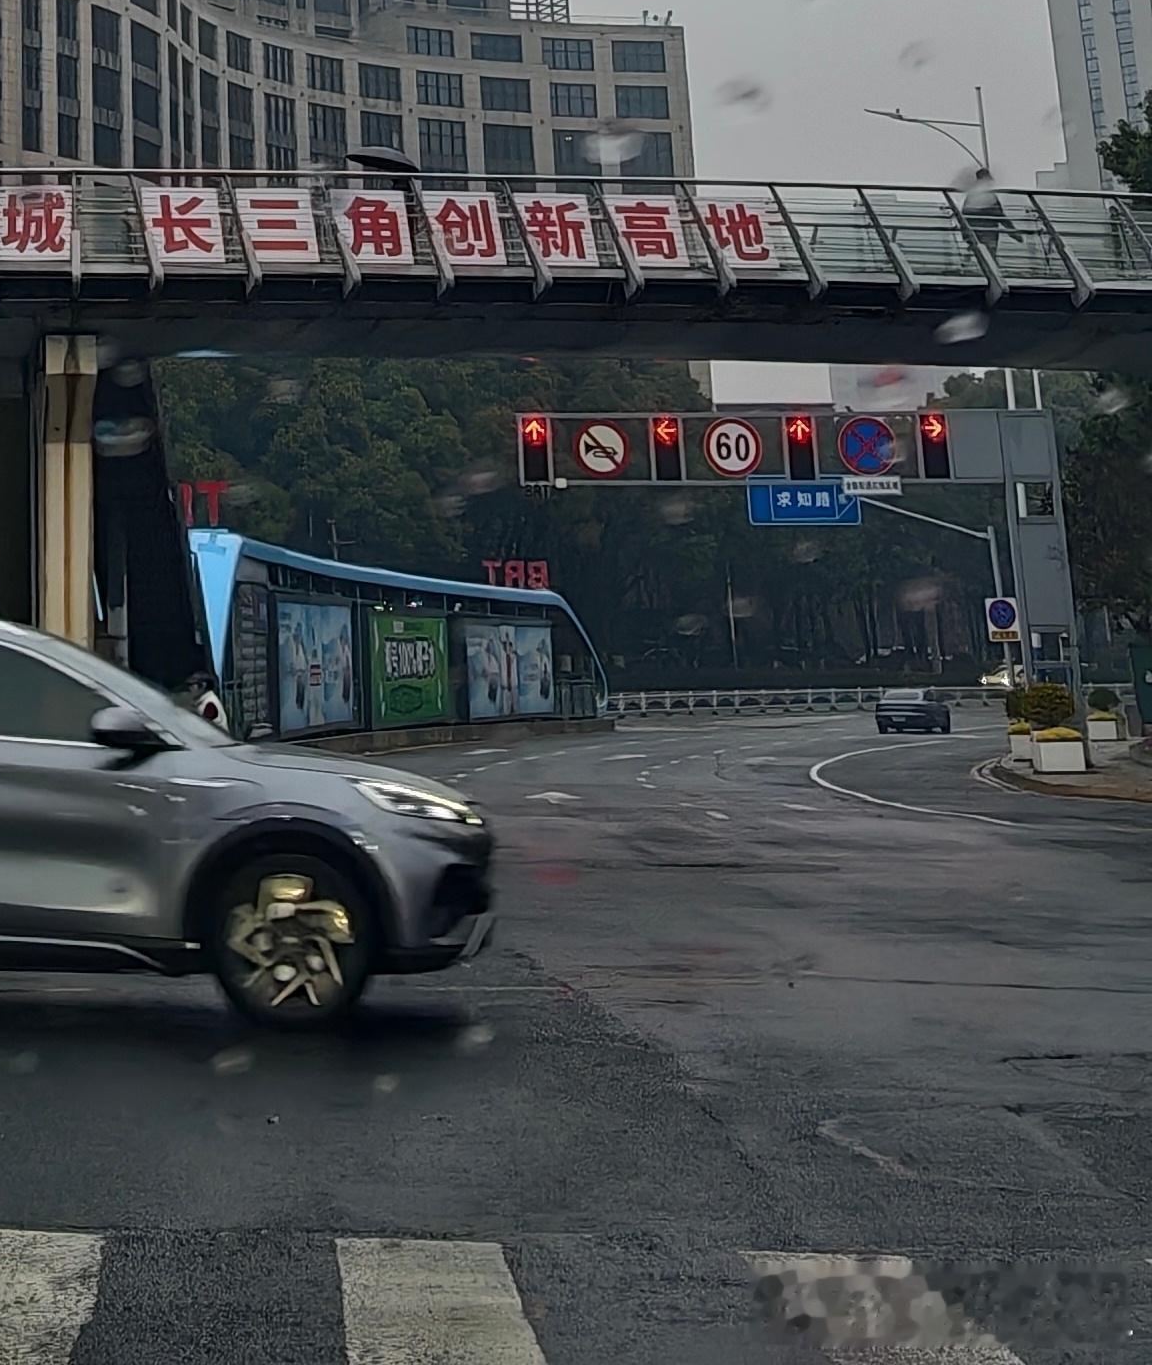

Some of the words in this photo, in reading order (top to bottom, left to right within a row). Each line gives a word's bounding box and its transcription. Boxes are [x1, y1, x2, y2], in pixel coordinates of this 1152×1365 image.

[151, 194, 770, 261] 长三角创新高地
[715, 432, 750, 462] 60
